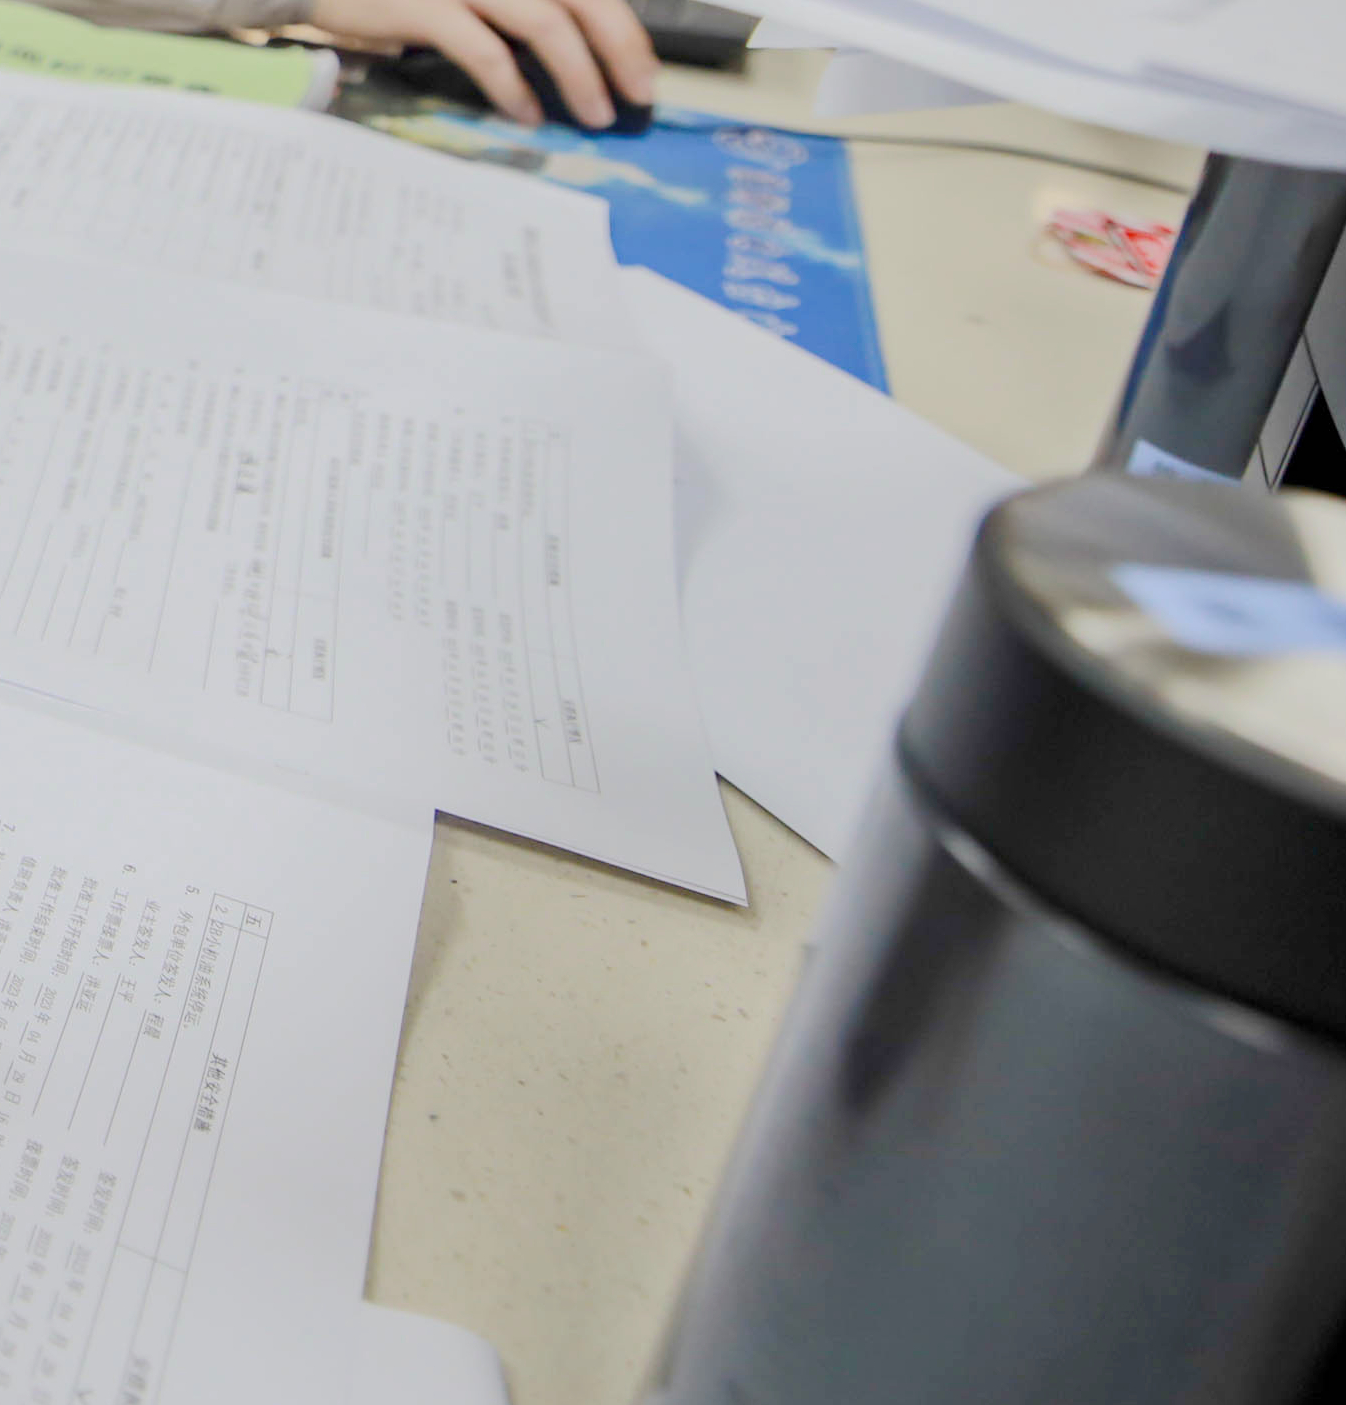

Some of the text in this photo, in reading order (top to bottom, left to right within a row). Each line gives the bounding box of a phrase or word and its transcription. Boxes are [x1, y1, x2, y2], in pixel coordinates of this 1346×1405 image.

[193, 1053, 228, 1132] 其他安全措施
